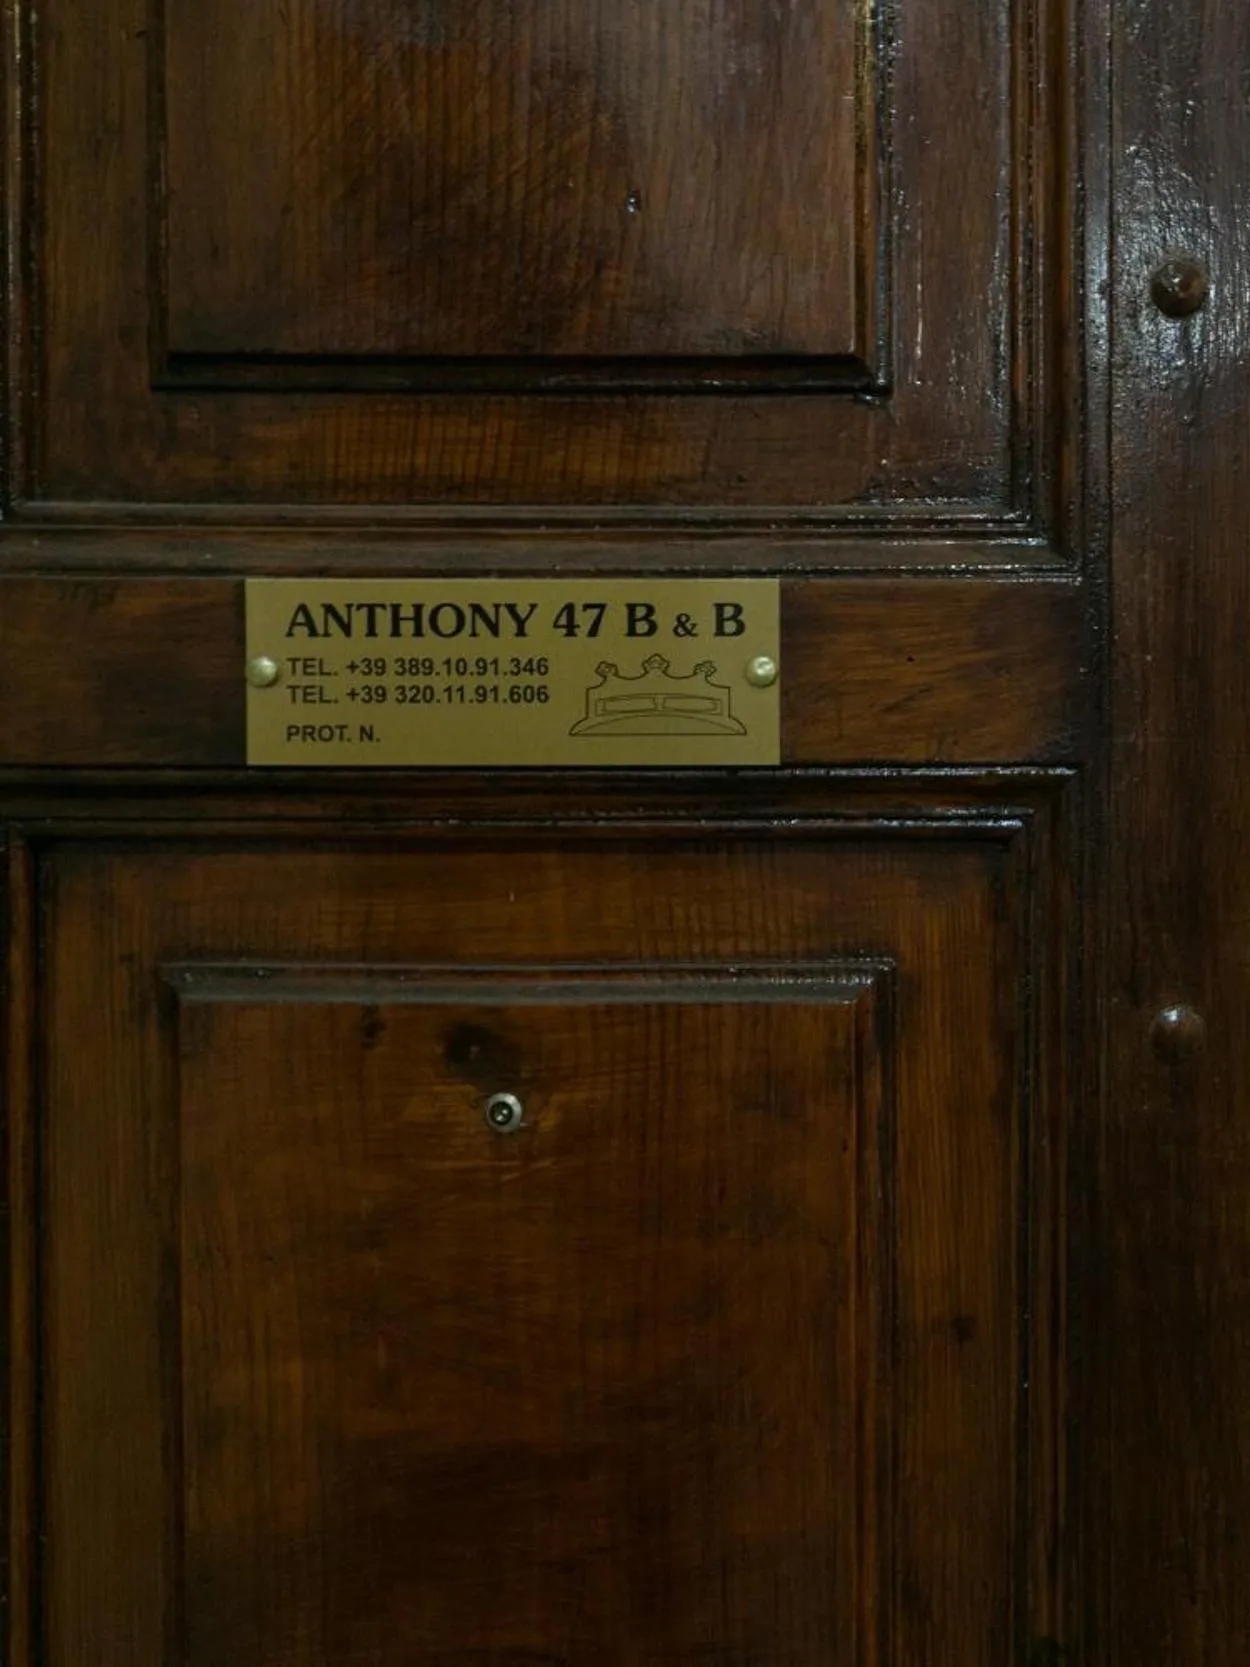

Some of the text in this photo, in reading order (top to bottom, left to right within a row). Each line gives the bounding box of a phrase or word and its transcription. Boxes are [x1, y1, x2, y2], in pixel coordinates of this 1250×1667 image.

[285, 602, 746, 639] ANTHONY 47 B & B
[286, 657, 550, 677] TEL. +39 389.10.91.346
[286, 684, 551, 705] TEL. +39 320.11.91.606
[286, 724, 381, 744] PROT. N.
